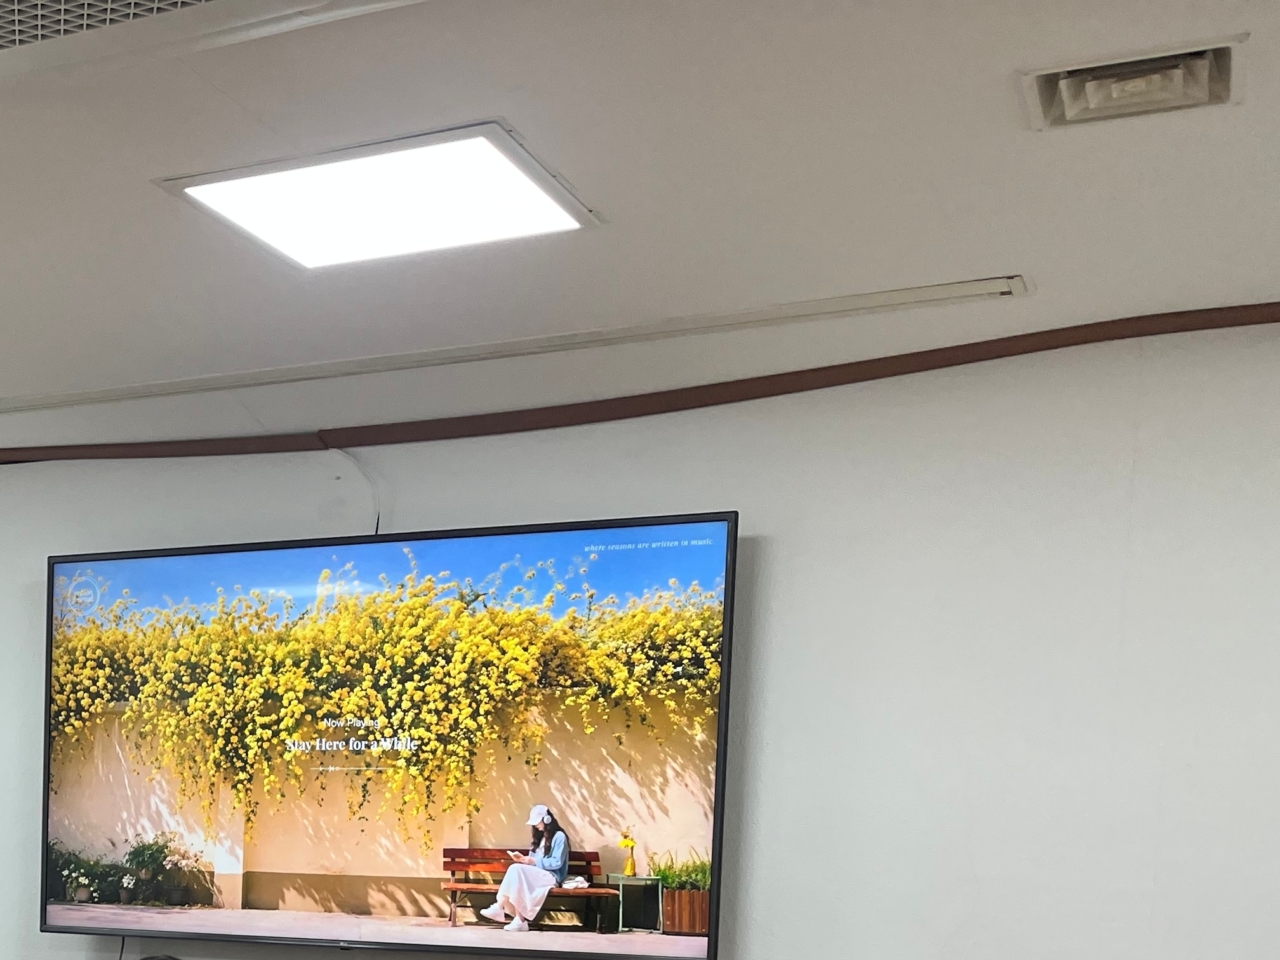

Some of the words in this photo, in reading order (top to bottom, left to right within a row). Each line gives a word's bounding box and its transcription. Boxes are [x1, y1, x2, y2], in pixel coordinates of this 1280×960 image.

[584, 544, 606, 552] where
[651, 539, 679, 548] written
[323, 717, 344, 728] Now
[347, 718, 380, 730] Playing
[286, 739, 313, 754] Stay
[315, 738, 346, 751] Here
[349, 737, 368, 750] for
[370, 741, 379, 751] a
[380, 737, 418, 750] While
